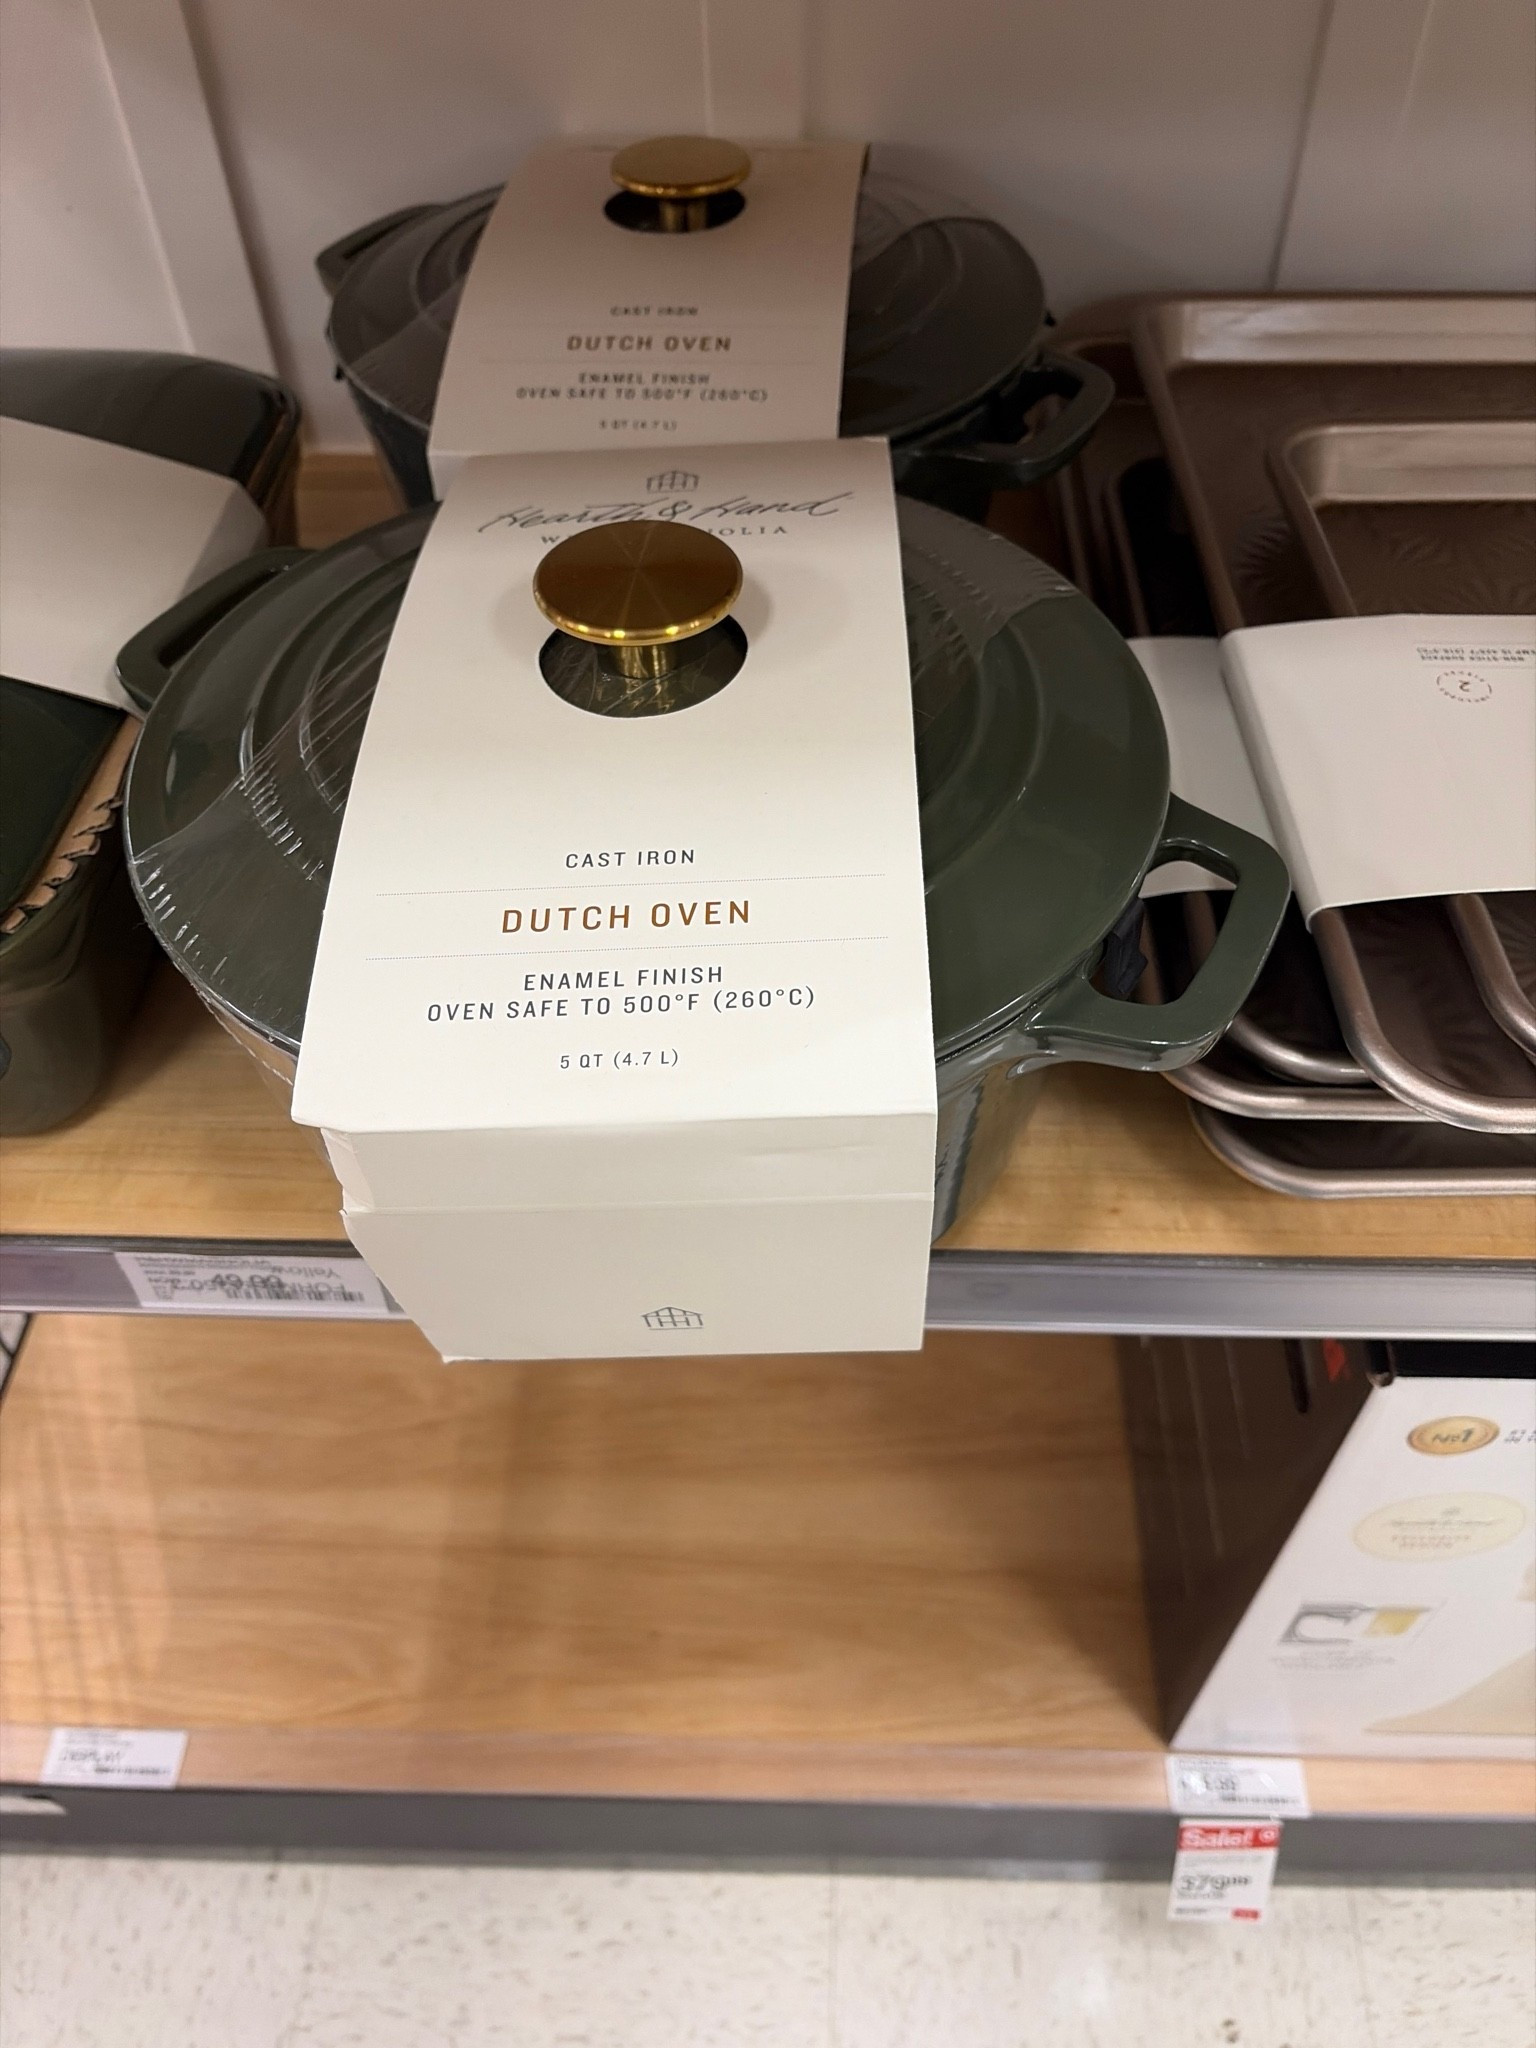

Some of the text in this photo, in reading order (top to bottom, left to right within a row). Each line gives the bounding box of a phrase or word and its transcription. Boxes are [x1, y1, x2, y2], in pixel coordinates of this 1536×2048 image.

[609, 306, 651, 317] CAST
[566, 335, 732, 352] DUTCH OVEN
[578, 372, 710, 384] ENAMEL FINISH
[516, 387, 561, 399] OVEN
[566, 387, 607, 399] SAFE
[615, 387, 636, 399] TO
[478, 491, 852, 533] Hearth & Hand
[1459, 680, 1471, 692] 2
[565, 849, 695, 869] CAST IRON
[502, 900, 751, 933] DUTCH OVEN
[523, 966, 723, 991] ENAMEL FINISH
[427, 985, 815, 1022] OVEN SAFE TO 500°F (260°C)
[560, 1048, 679, 1070] 5 QT (4.7 L)
